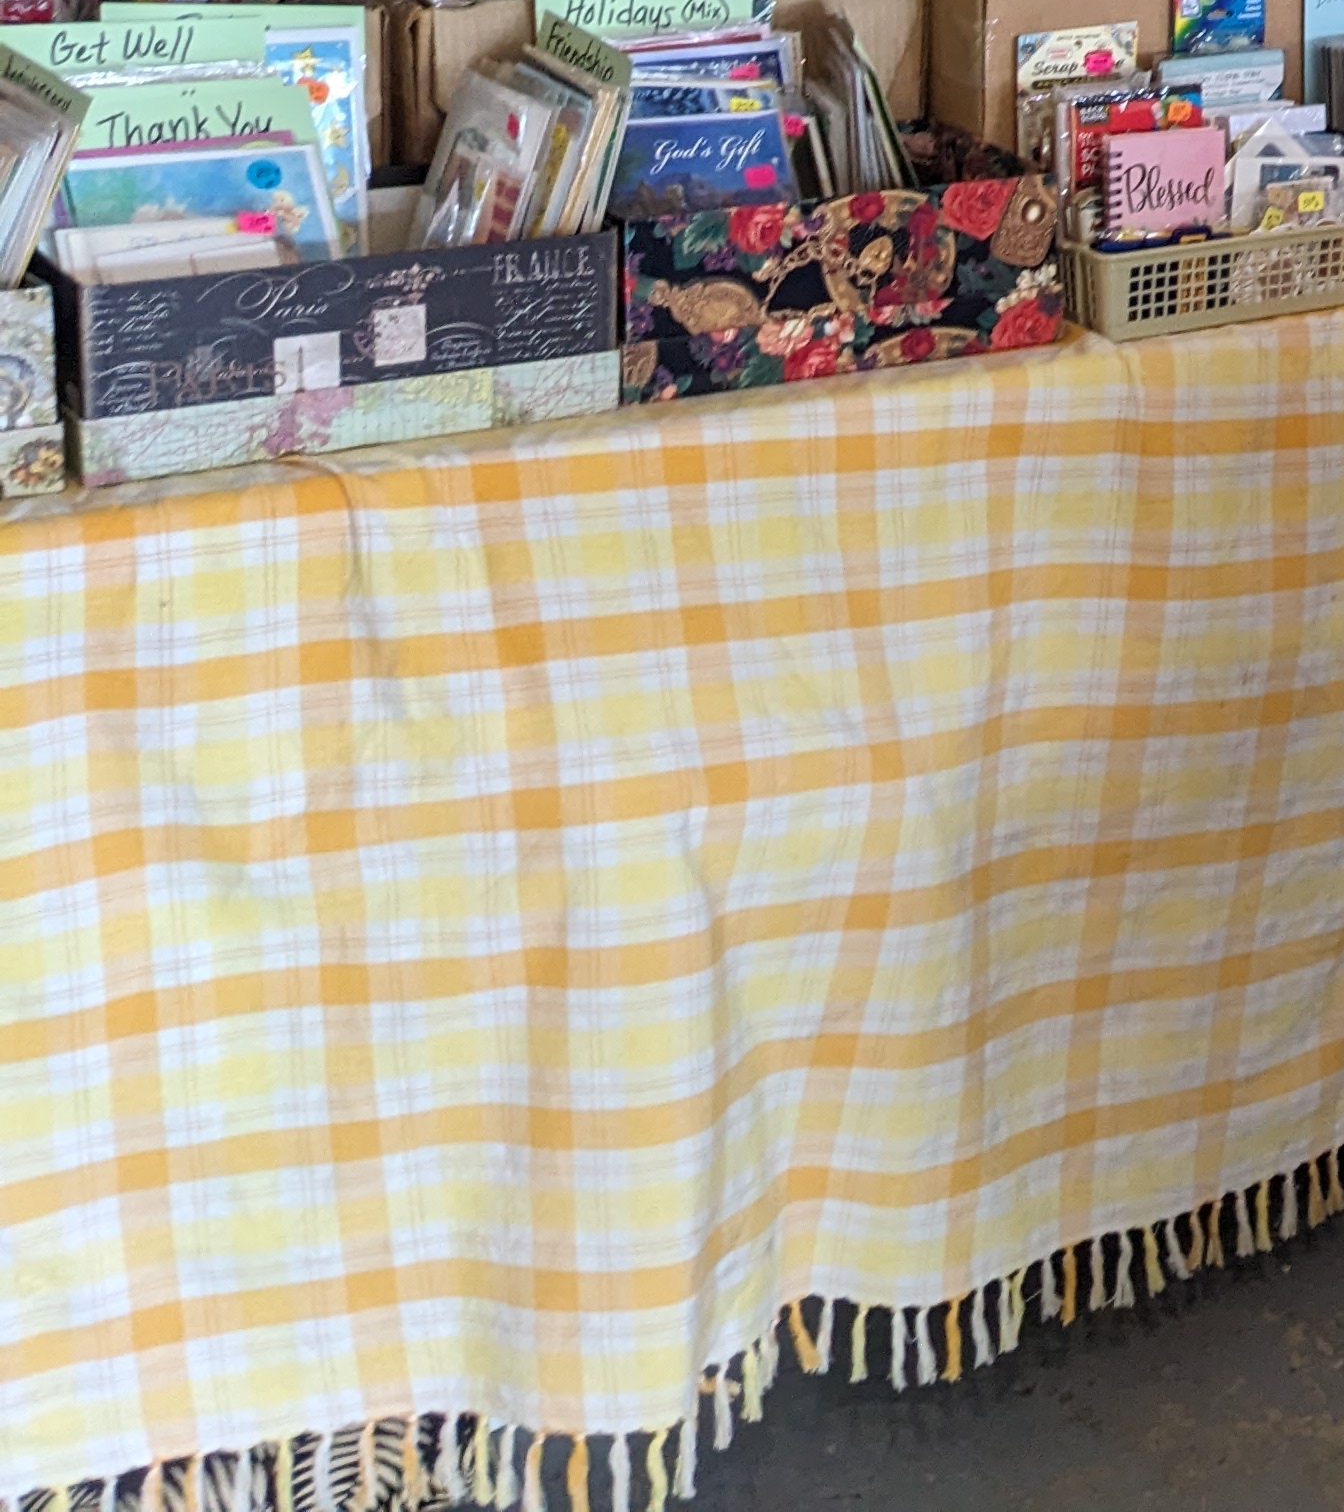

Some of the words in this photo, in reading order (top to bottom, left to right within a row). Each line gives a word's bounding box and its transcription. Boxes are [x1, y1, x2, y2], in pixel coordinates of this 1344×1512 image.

[50, 30, 109, 66] Get
[122, 25, 194, 63] Well
[545, 19, 615, 83] Friendship
[96, 102, 211, 148] Thank
[216, 101, 273, 136] You
[650, 135, 712, 175] God's
[715, 128, 765, 171] Gift
[1121, 163, 1215, 215] Blessed
[491, 245, 595, 286] FRANCE
